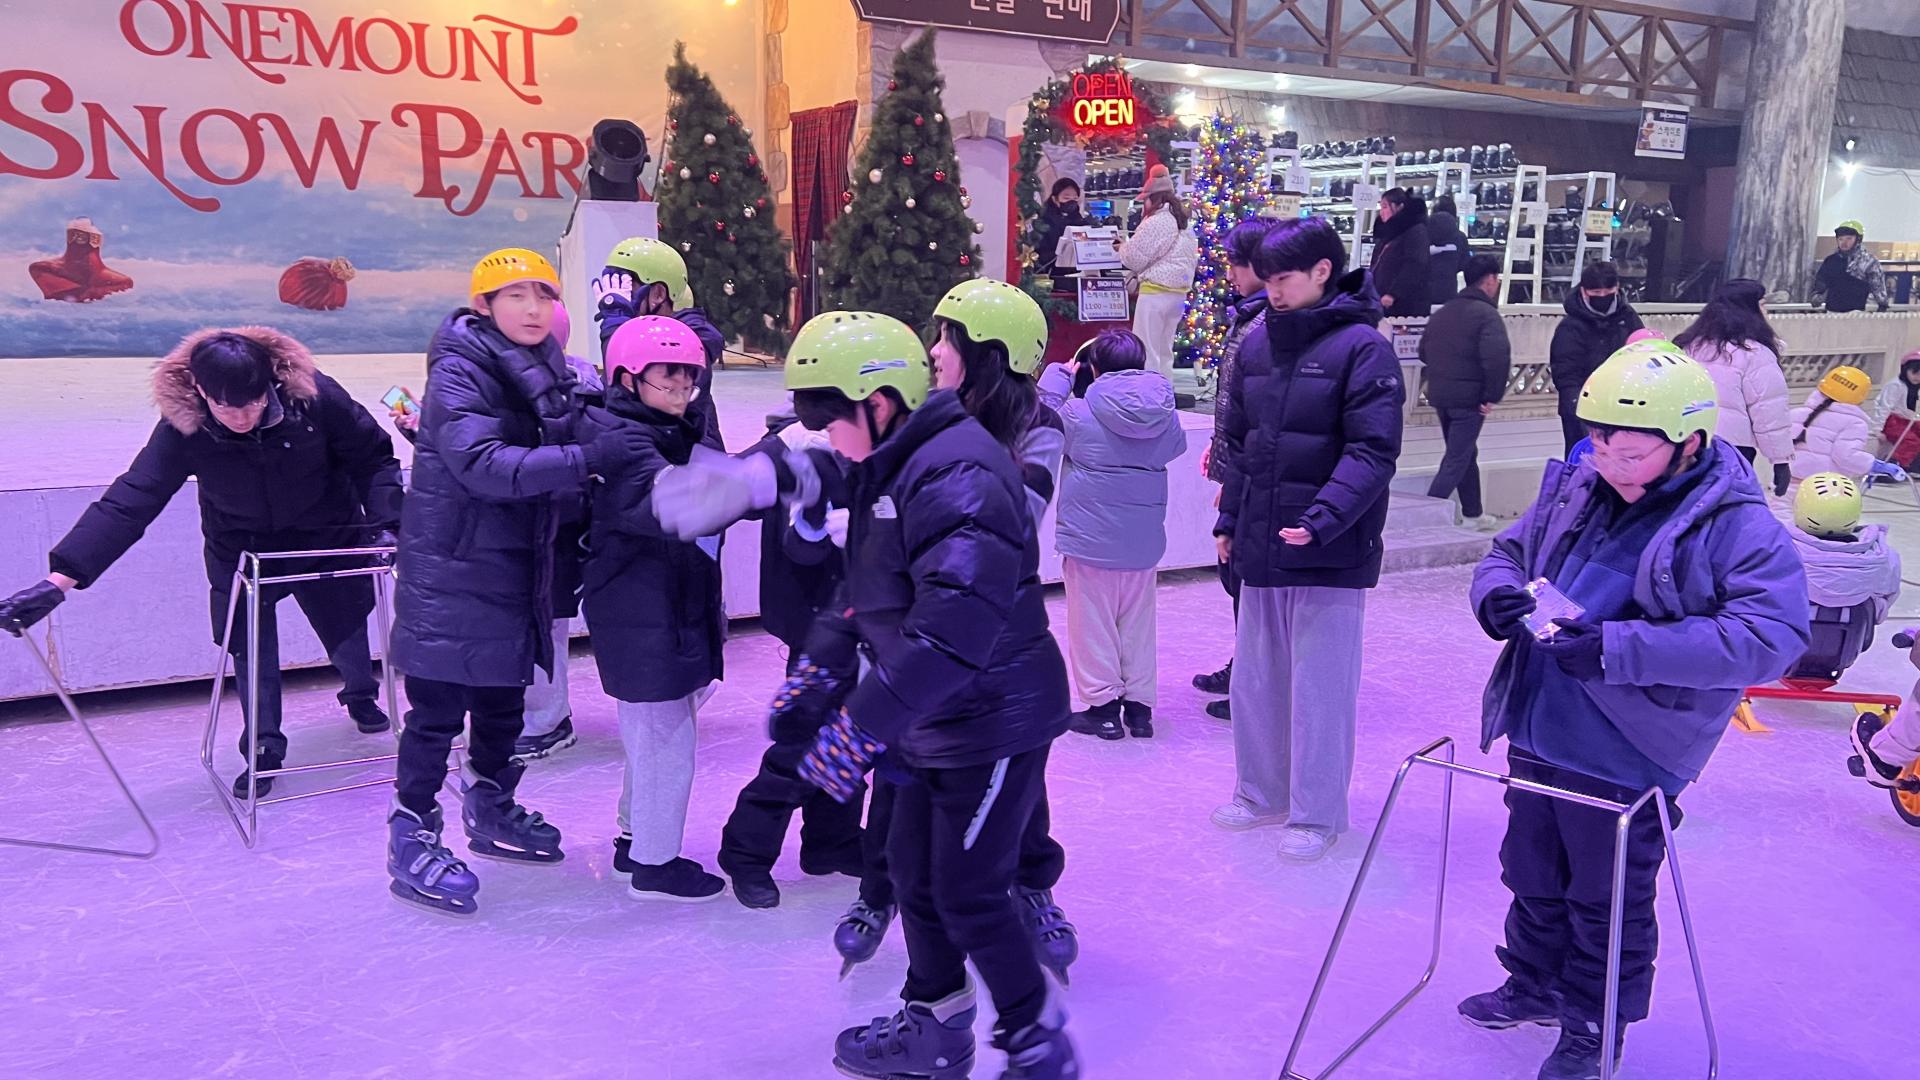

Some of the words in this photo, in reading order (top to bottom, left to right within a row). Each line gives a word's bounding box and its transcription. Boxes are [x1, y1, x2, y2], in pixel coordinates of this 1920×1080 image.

[119, 0, 577, 105] ONEMOUNT
[1073, 73, 1134, 98] OPEN
[1074, 99, 1134, 126] OPEN
[0, 69, 381, 213] SNOW
[391, 102, 652, 217] PAR
[1291, 175, 1305, 185] 210
